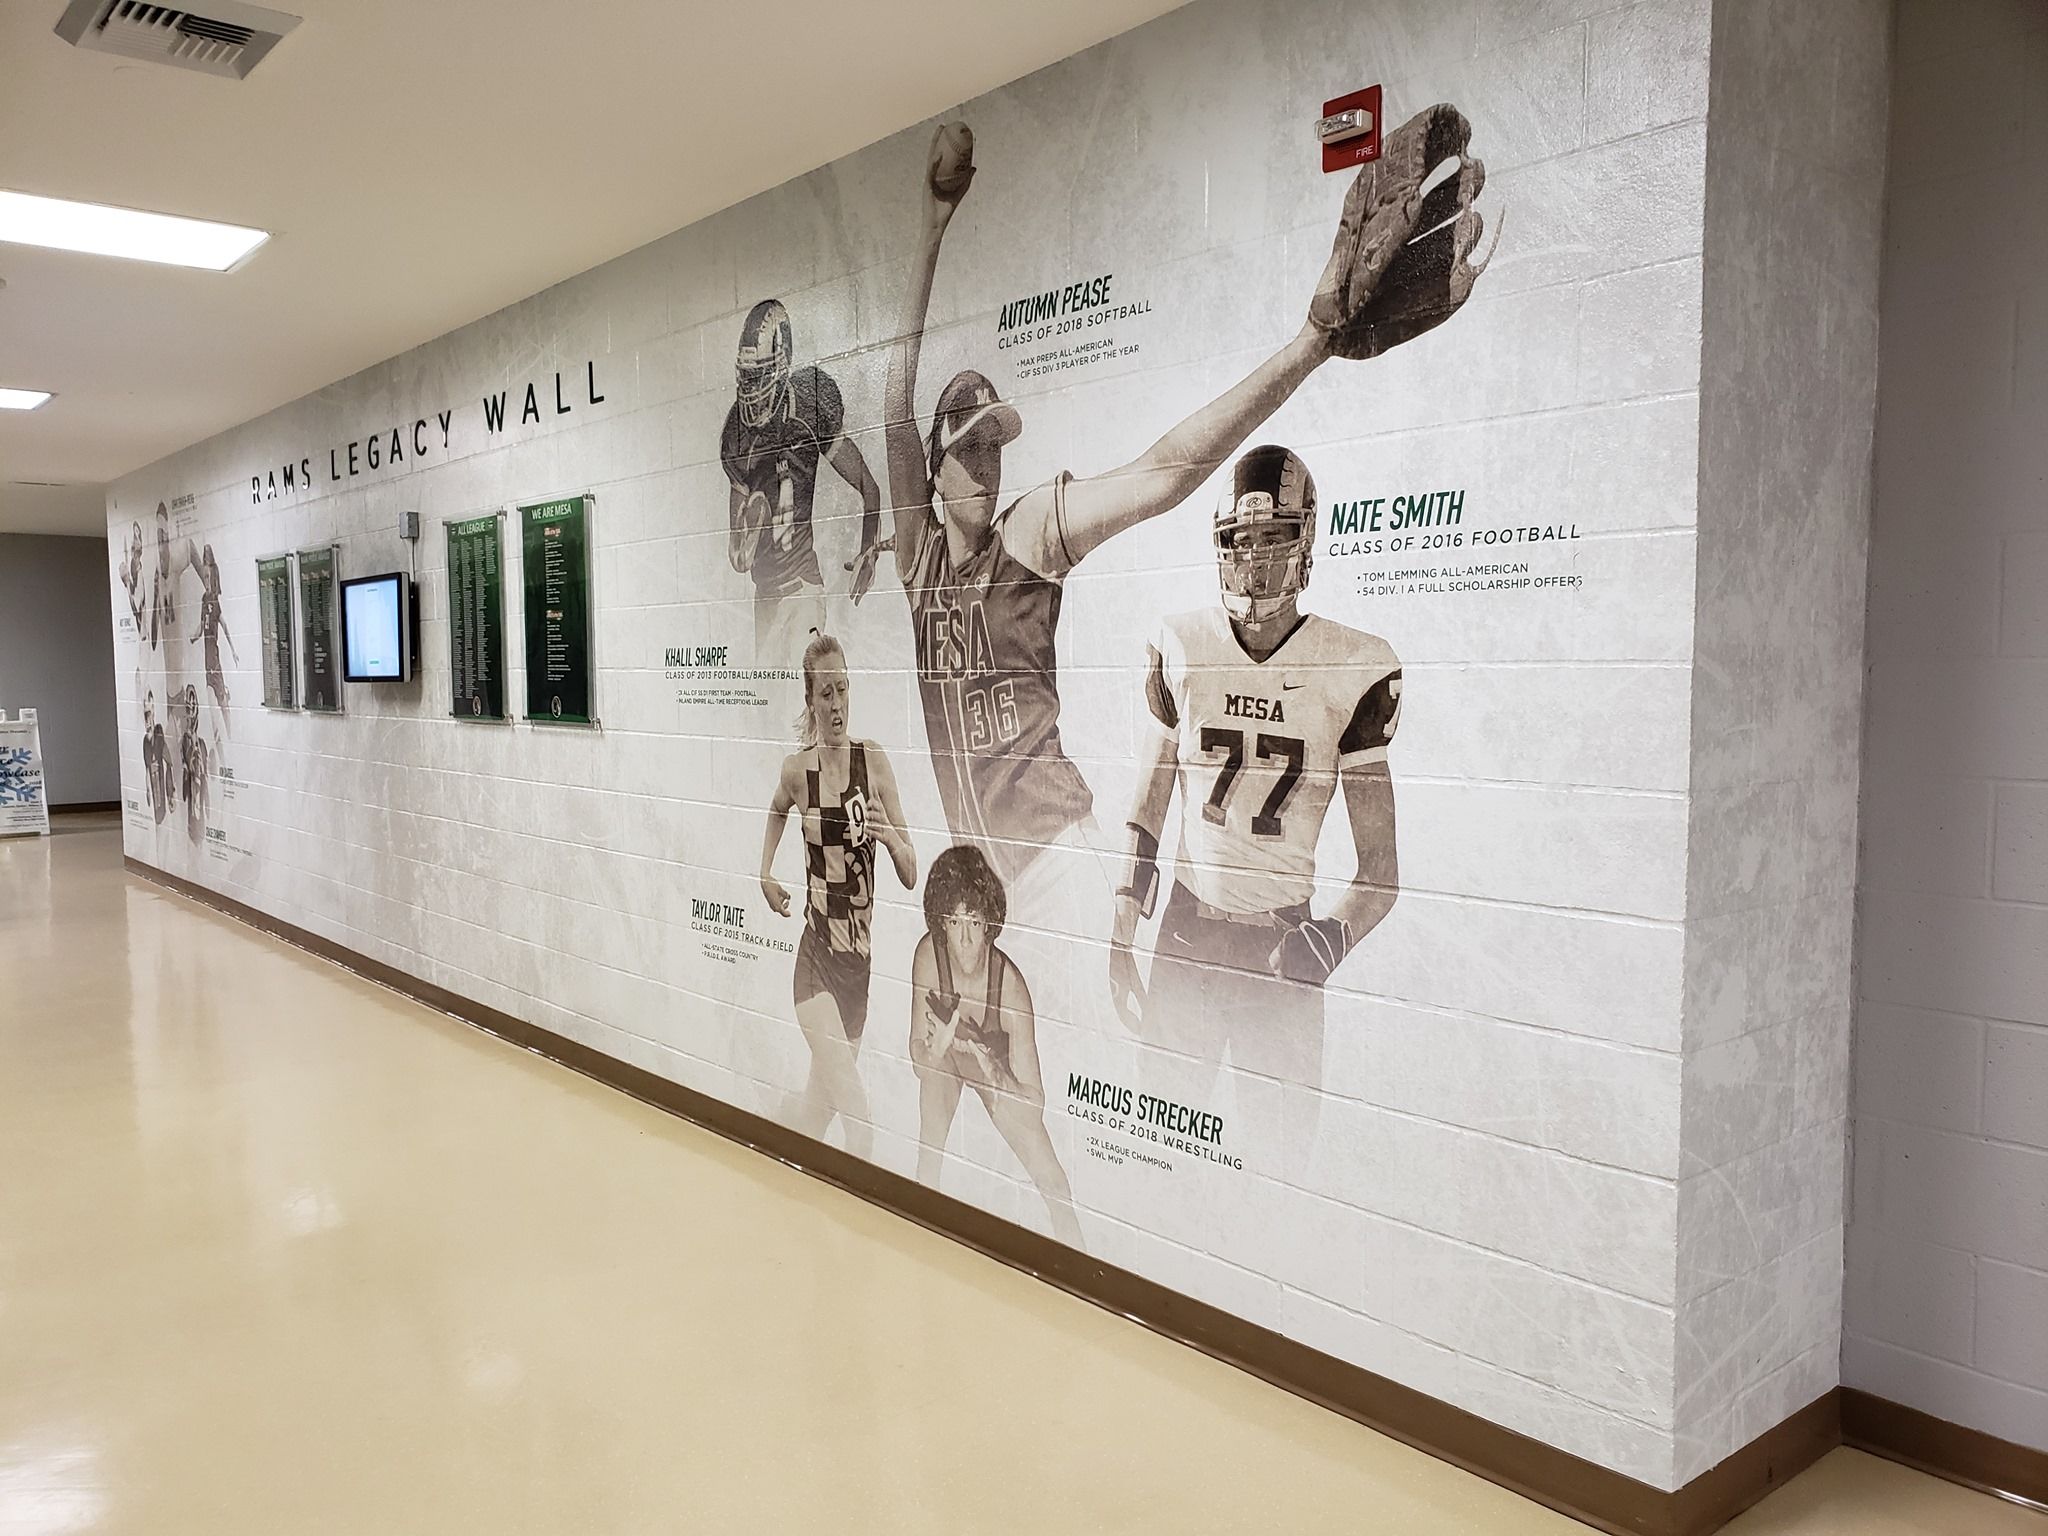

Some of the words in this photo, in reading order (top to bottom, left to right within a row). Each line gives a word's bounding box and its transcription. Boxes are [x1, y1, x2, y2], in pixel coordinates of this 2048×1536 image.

[1356, 146, 1373, 159] FIRE
[998, 290, 1059, 332] AUTUMN
[1062, 274, 1112, 315] PEASE
[998, 331, 1032, 349] CLASS
[1037, 326, 1052, 340] OF
[1057, 318, 1082, 335] 2018
[1088, 300, 1152, 327] SOFTBALL
[1021, 356, 1035, 366] MAX
[1037, 351, 1057, 364] PREPS
[1059, 338, 1113, 358] ALL-AMERICAN
[1021, 370, 1031, 379] CIF
[1033, 367, 1040, 376] SS
[1043, 364, 1053, 374] DIV
[1056, 362, 1060, 371] 3
[1062, 354, 1088, 369] PLAYER
[1091, 353, 1100, 362] OF
[1103, 350, 1116, 360] THE
[1119, 344, 1139, 356] YEAR
[252, 459, 311, 504] RAMS
[331, 410, 451, 481] LEGACY
[483, 361, 604, 434] WALL
[532, 508, 541, 520] WE
[542, 506, 554, 518] ARE
[555, 503, 572, 516] MESA
[1330, 498, 1384, 535] NATE
[1390, 490, 1465, 530] SMITH
[458, 525, 466, 536] ALL
[467, 522, 485, 535] LEAGUE
[1330, 541, 1382, 556] CLASS
[1390, 537, 1414, 552] OF
[1422, 533, 1463, 549] 2016
[1472, 524, 1580, 546] FOOTBALL
[1363, 572, 1384, 582] TOM
[1388, 568, 1437, 580] LEMMING
[1441, 563, 1528, 577] ALL-AMERICAN
[1378, 585, 1398, 595] DIV.
[1407, 584, 1415, 594] A
[1418, 582, 1445, 593] FULL
[1449, 578, 1530, 592] SCHOLARSHIP
[1534, 576, 1582, 588] OFFERS
[665, 648, 692, 666] KHALIL
[695, 647, 728, 666] SHARPE
[714, 670, 799, 680] FOOTBALL/BASKETBALL
[966, 678, 1020, 750] 36
[1224, 694, 1284, 722] MESA
[1200, 727, 1306, 838] 77
[692, 899, 720, 923] TAYLOR
[724, 905, 744, 928] TAITE
[691, 922, 710, 933] CLASS
[714, 927, 722, 935] OF
[725, 929, 739, 940] 2015
[741, 933, 764, 946] TRACK
[773, 940, 793, 952] FIELD
[1068, 1073, 1132, 1116] MARCUS
[1137, 1094, 1223, 1145] STRECKER
[1068, 1105, 1104, 1125] CLASS
[1109, 1117, 1126, 1130] OF
[1130, 1124, 1157, 1142] 2018
[1164, 1134, 1242, 1170] WRESTLING
[1090, 1137, 1100, 1147] 2X
[1101, 1140, 1130, 1157] LEAGUE
[1132, 1151, 1173, 1172] CHAMPION
[1090, 1148, 1106, 1160] SWL
[1108, 1154, 1123, 1166] MVP
